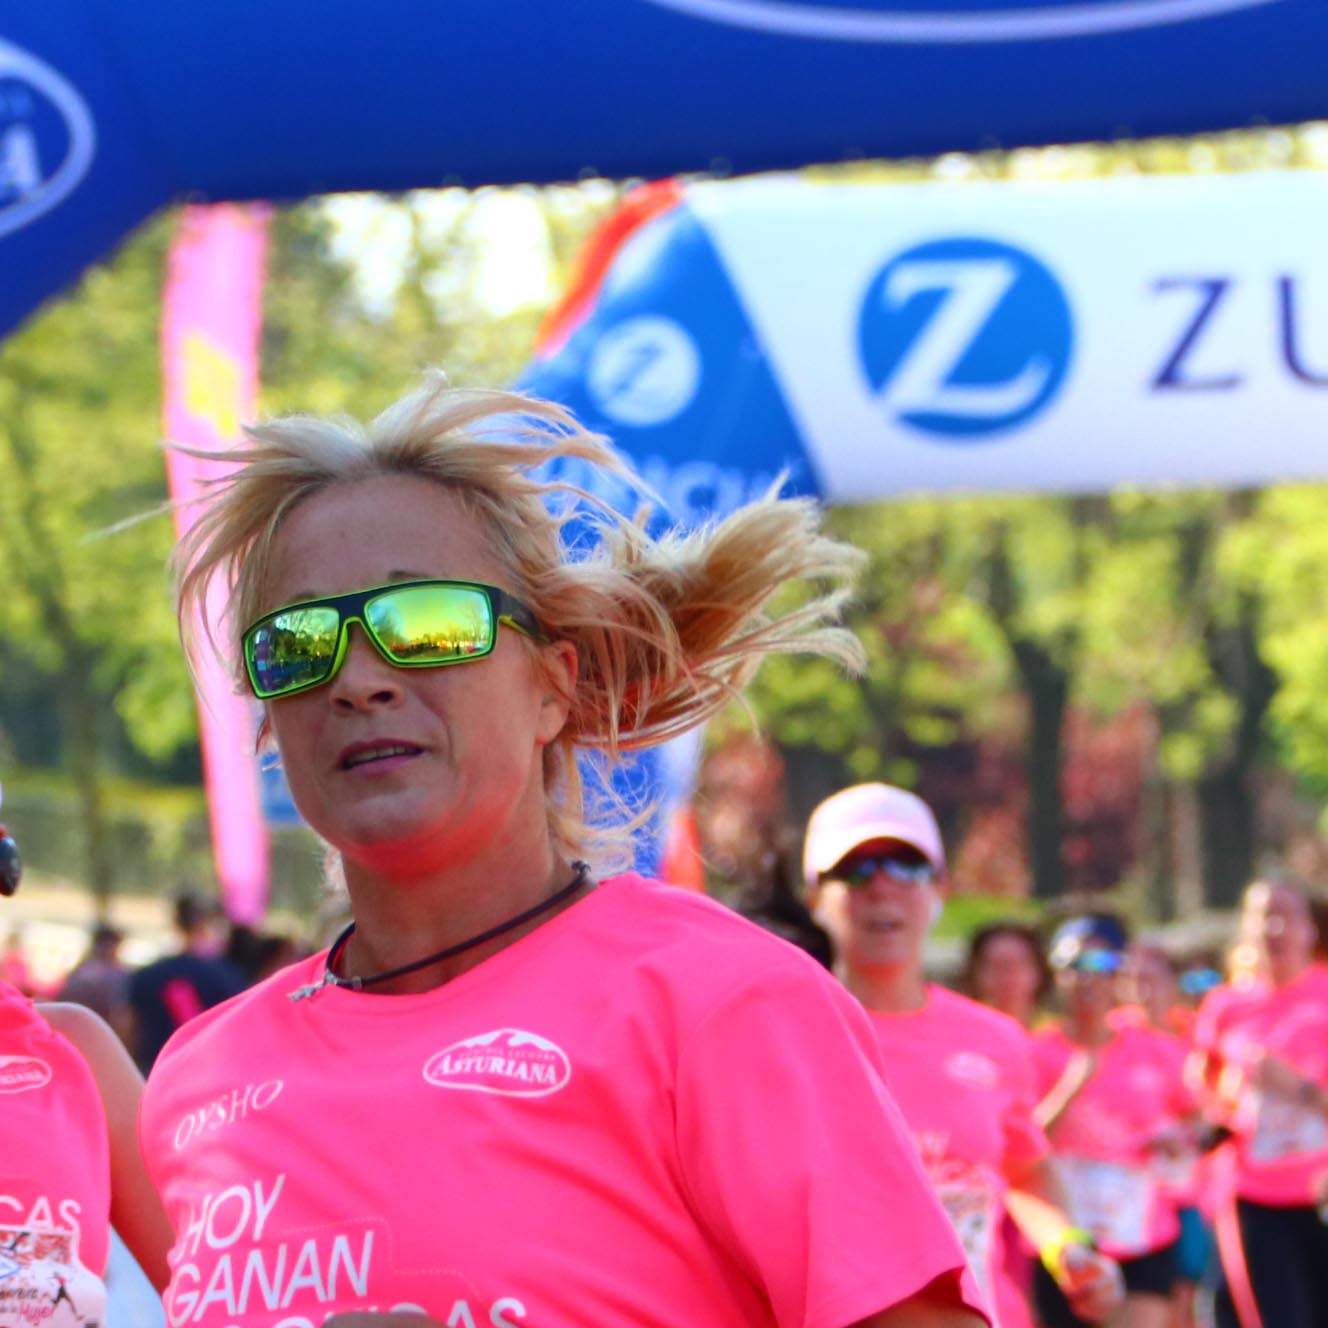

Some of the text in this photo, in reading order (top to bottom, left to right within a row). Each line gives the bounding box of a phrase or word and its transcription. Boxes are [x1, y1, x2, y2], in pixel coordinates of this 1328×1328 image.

[431, 1055, 558, 1085] ASTURIANA
[174, 1079, 285, 1150] OYSHO
[171, 1230, 374, 1328] GANAN
